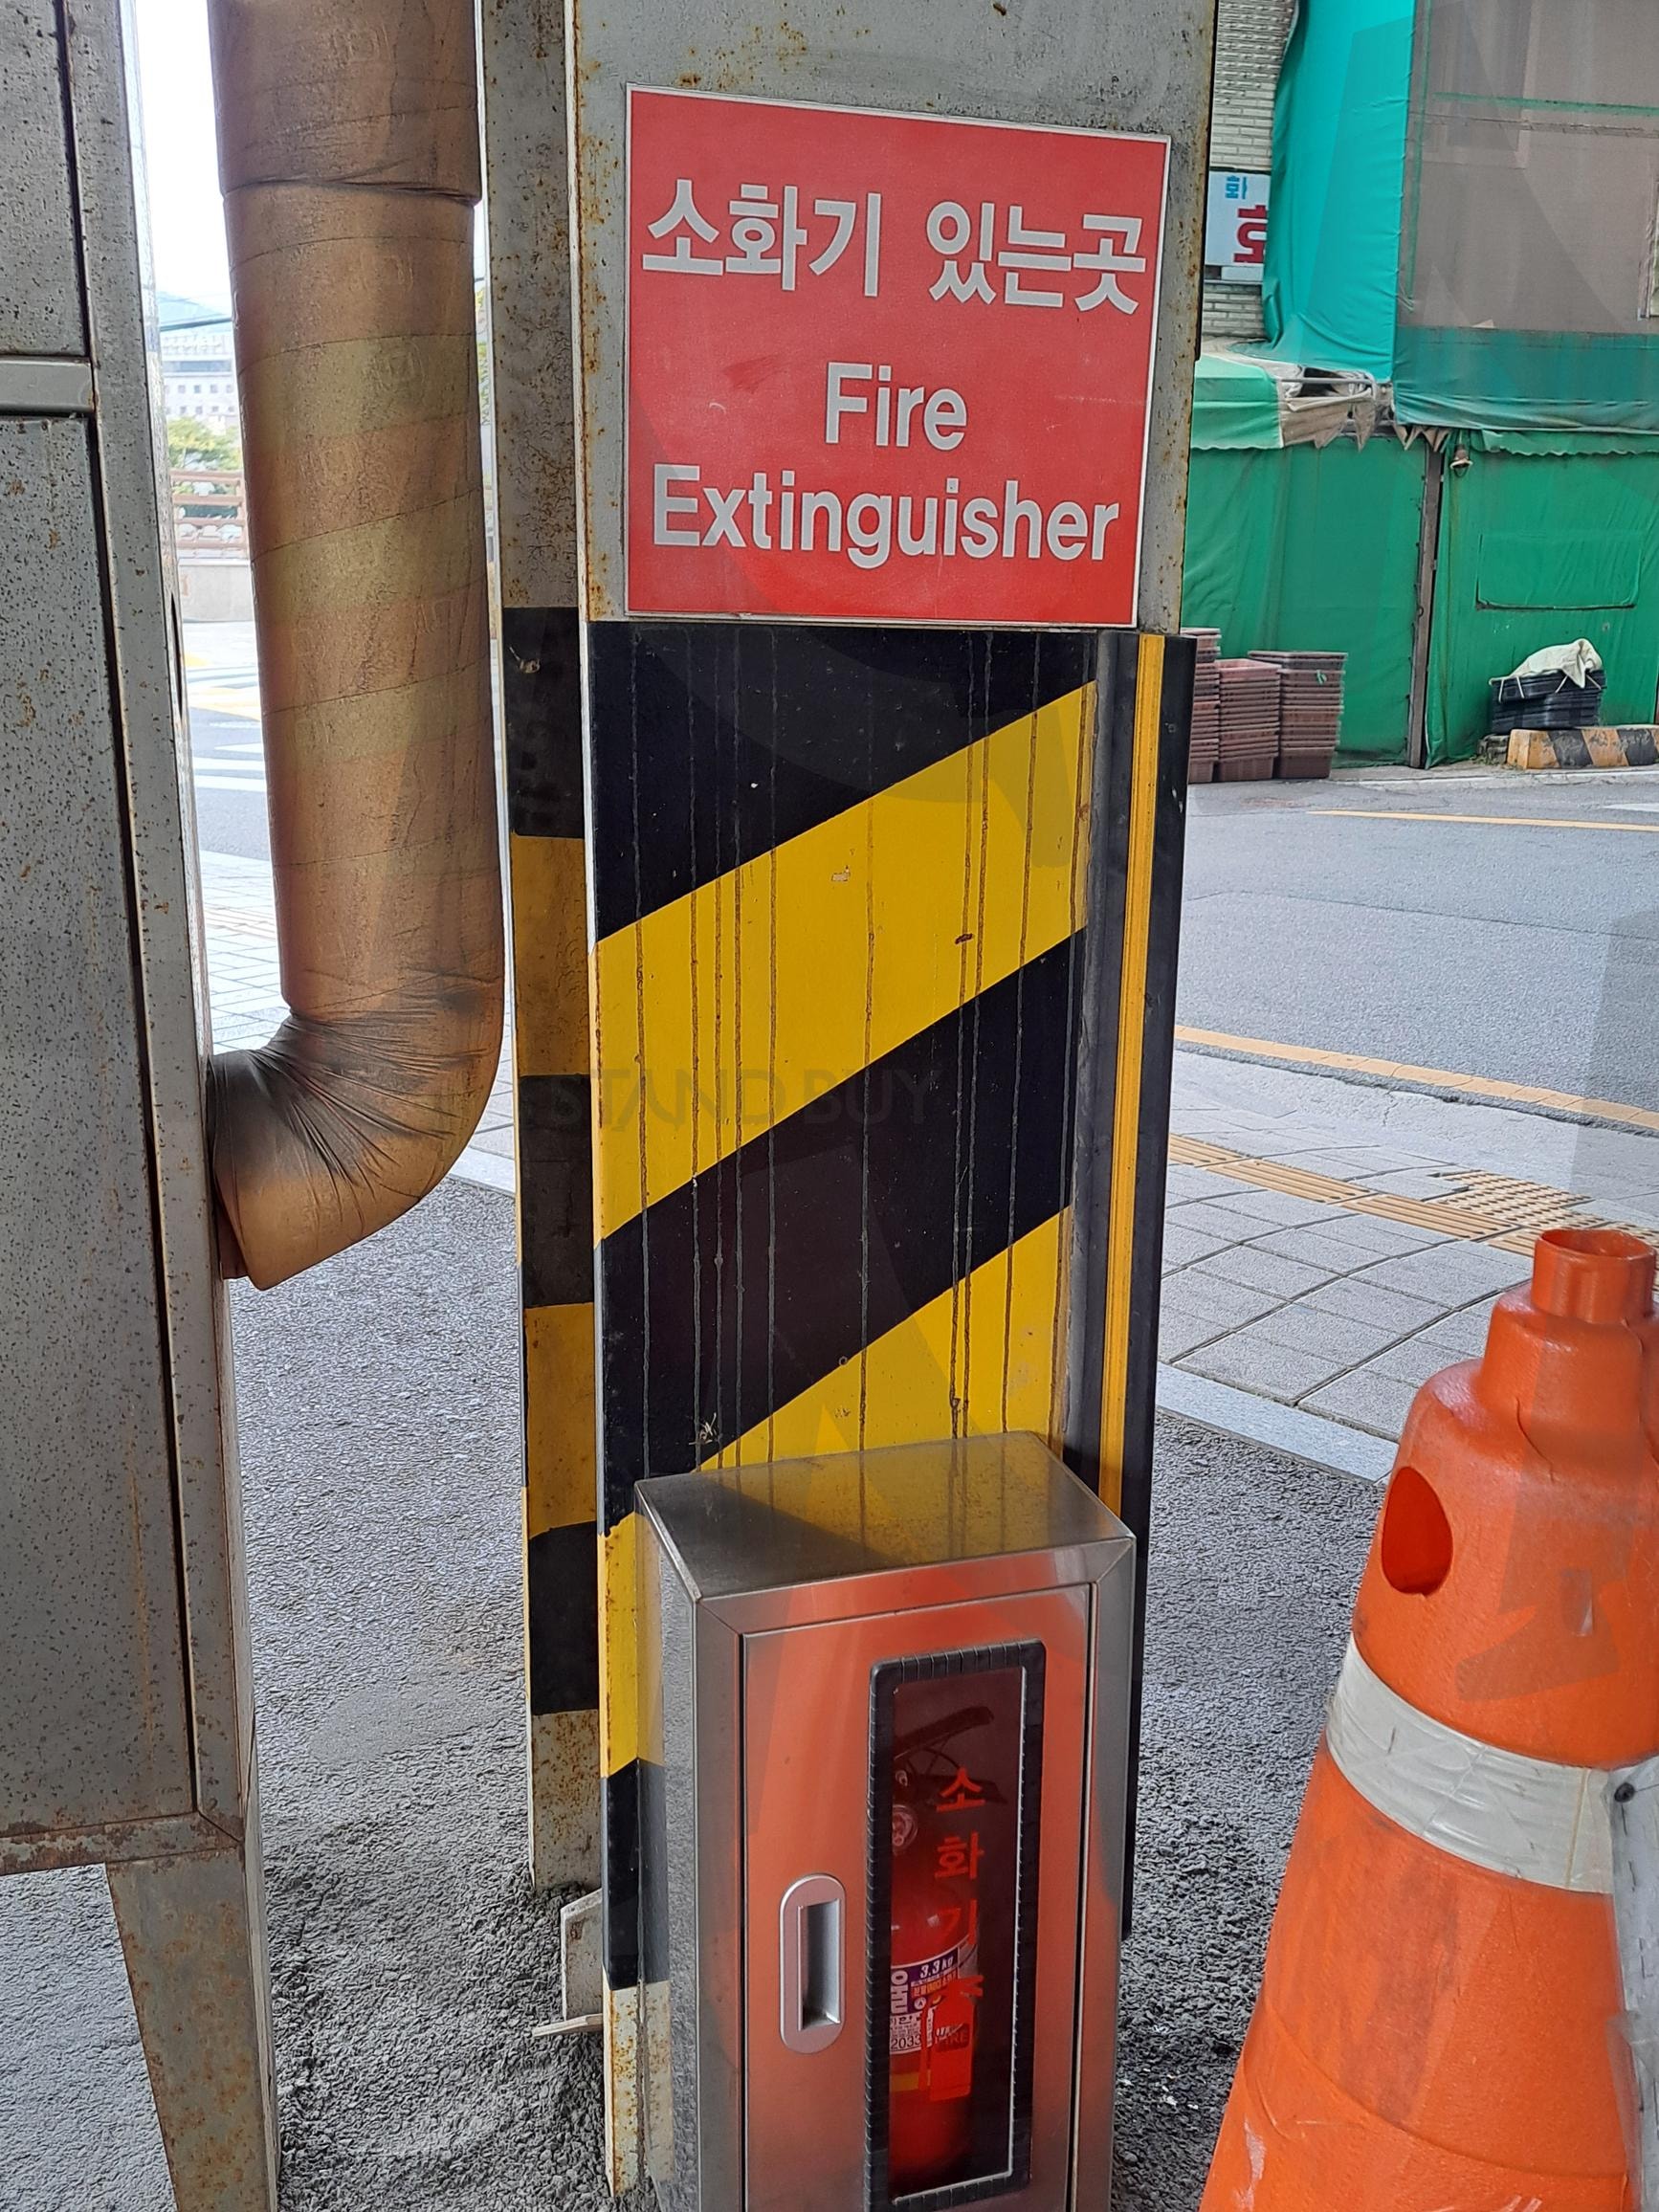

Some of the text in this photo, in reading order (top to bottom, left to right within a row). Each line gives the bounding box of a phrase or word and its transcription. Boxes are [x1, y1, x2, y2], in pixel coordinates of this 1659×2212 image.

[642, 179, 1147, 315] 소화기 있는곳
[825, 361, 967, 451] Fire
[652, 463, 1119, 569] Extinguisher
[934, 1766, 986, 1944] 소화기
